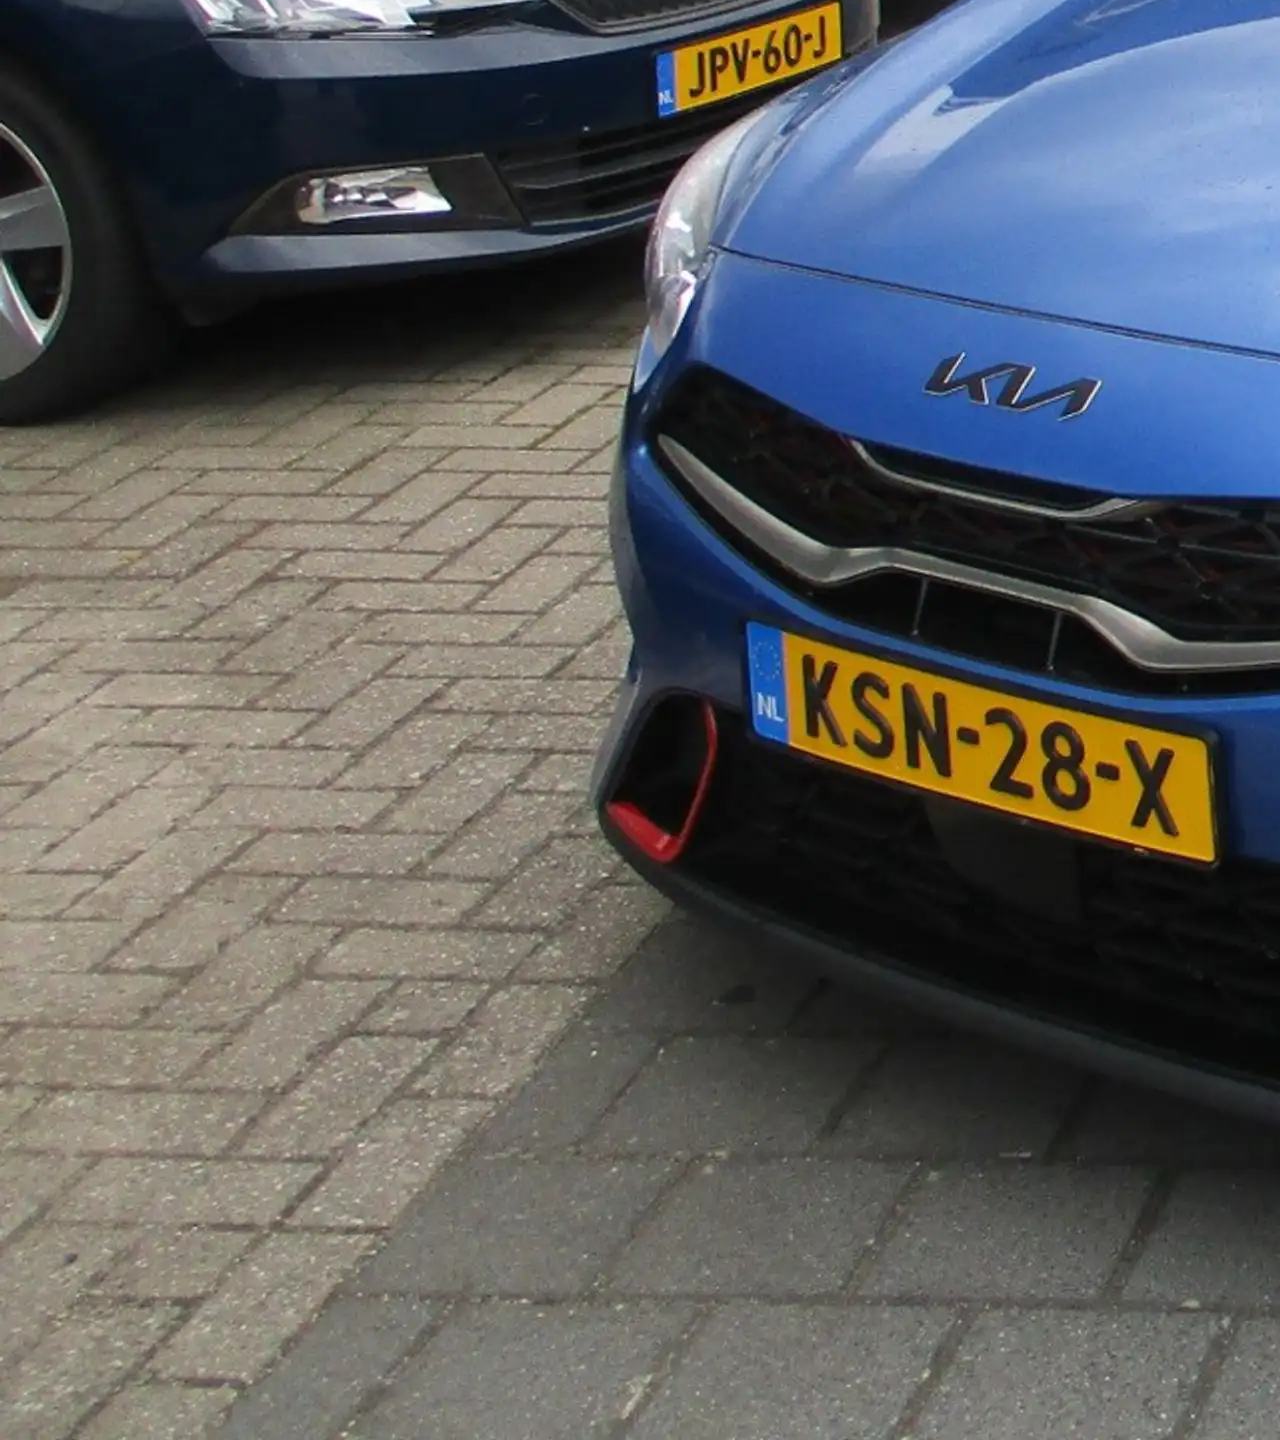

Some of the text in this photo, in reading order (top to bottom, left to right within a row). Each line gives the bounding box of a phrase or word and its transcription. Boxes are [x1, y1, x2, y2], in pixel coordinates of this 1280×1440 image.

[689, 15, 827, 98] JPV-60-J
[922, 351, 1103, 422] KIA
[755, 654, 1179, 838] NL KSN-28-X
